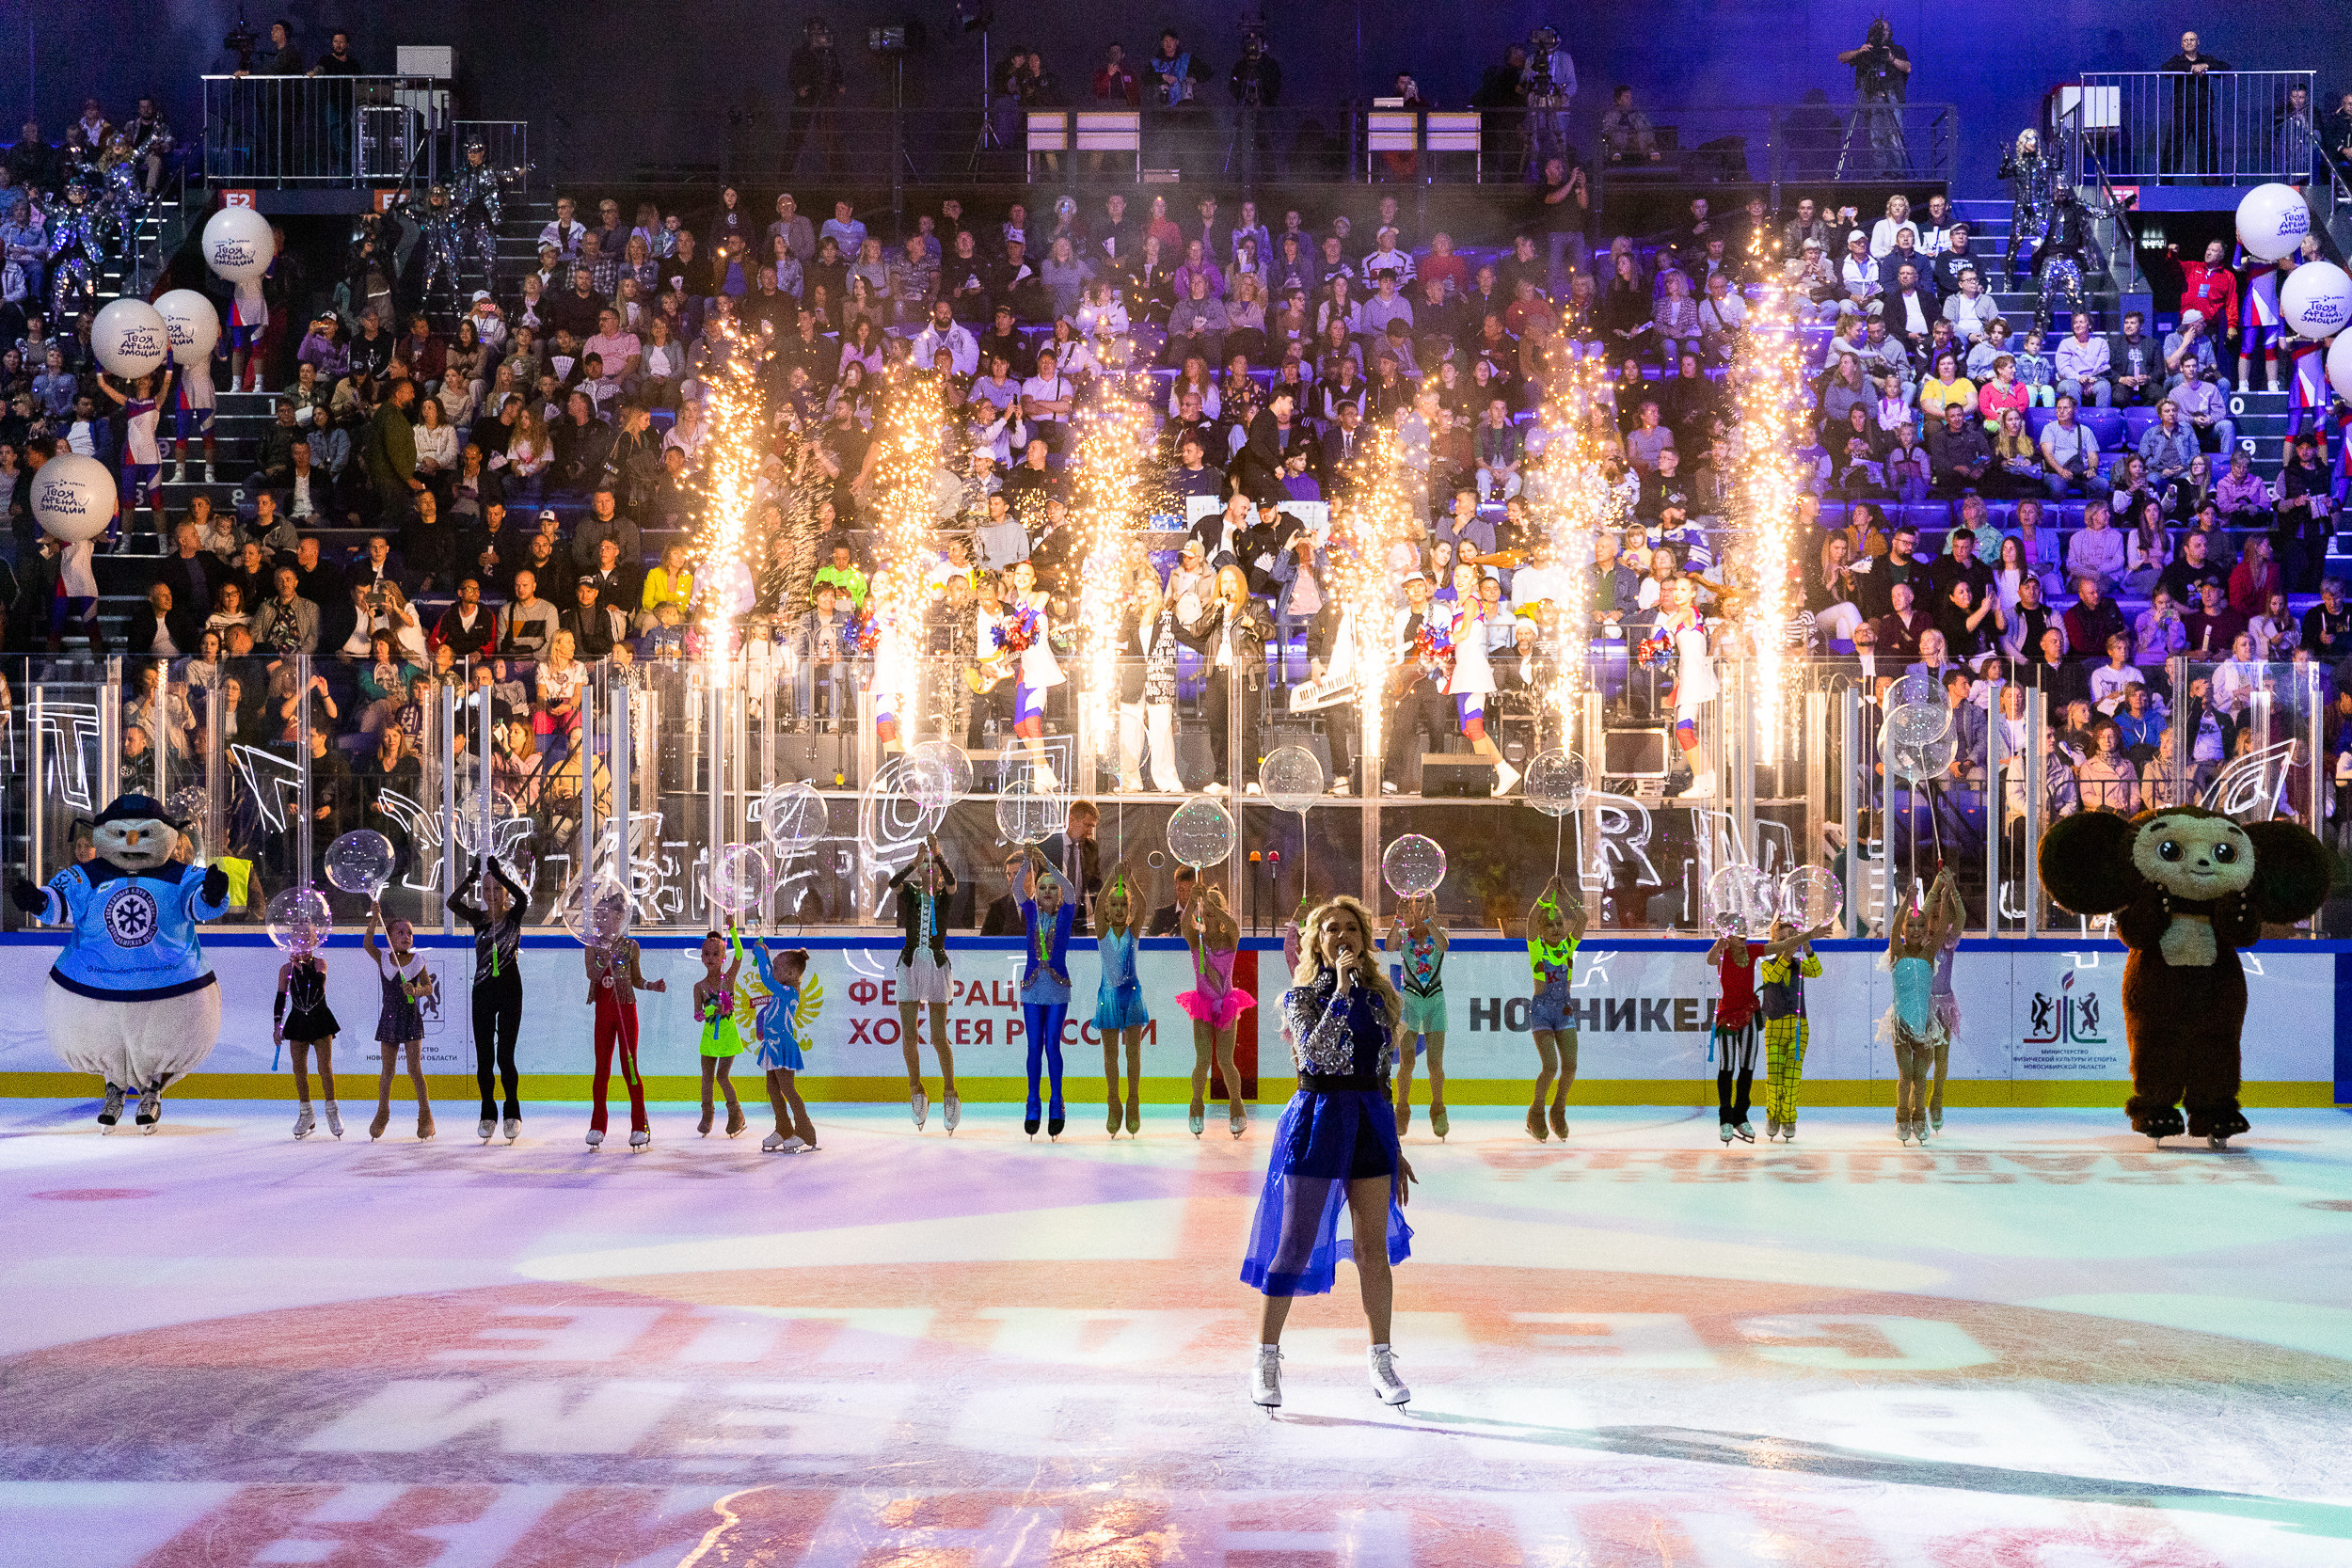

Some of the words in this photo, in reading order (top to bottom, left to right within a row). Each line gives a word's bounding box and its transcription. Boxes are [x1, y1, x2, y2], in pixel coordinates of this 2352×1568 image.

[2242, 439, 2256, 455] 9
[848, 978, 1025, 1012] ФЕРАЦ
[1470, 997, 1722, 1033] НОНИКЕ
[1006, 1019, 1157, 1046] РССИ
